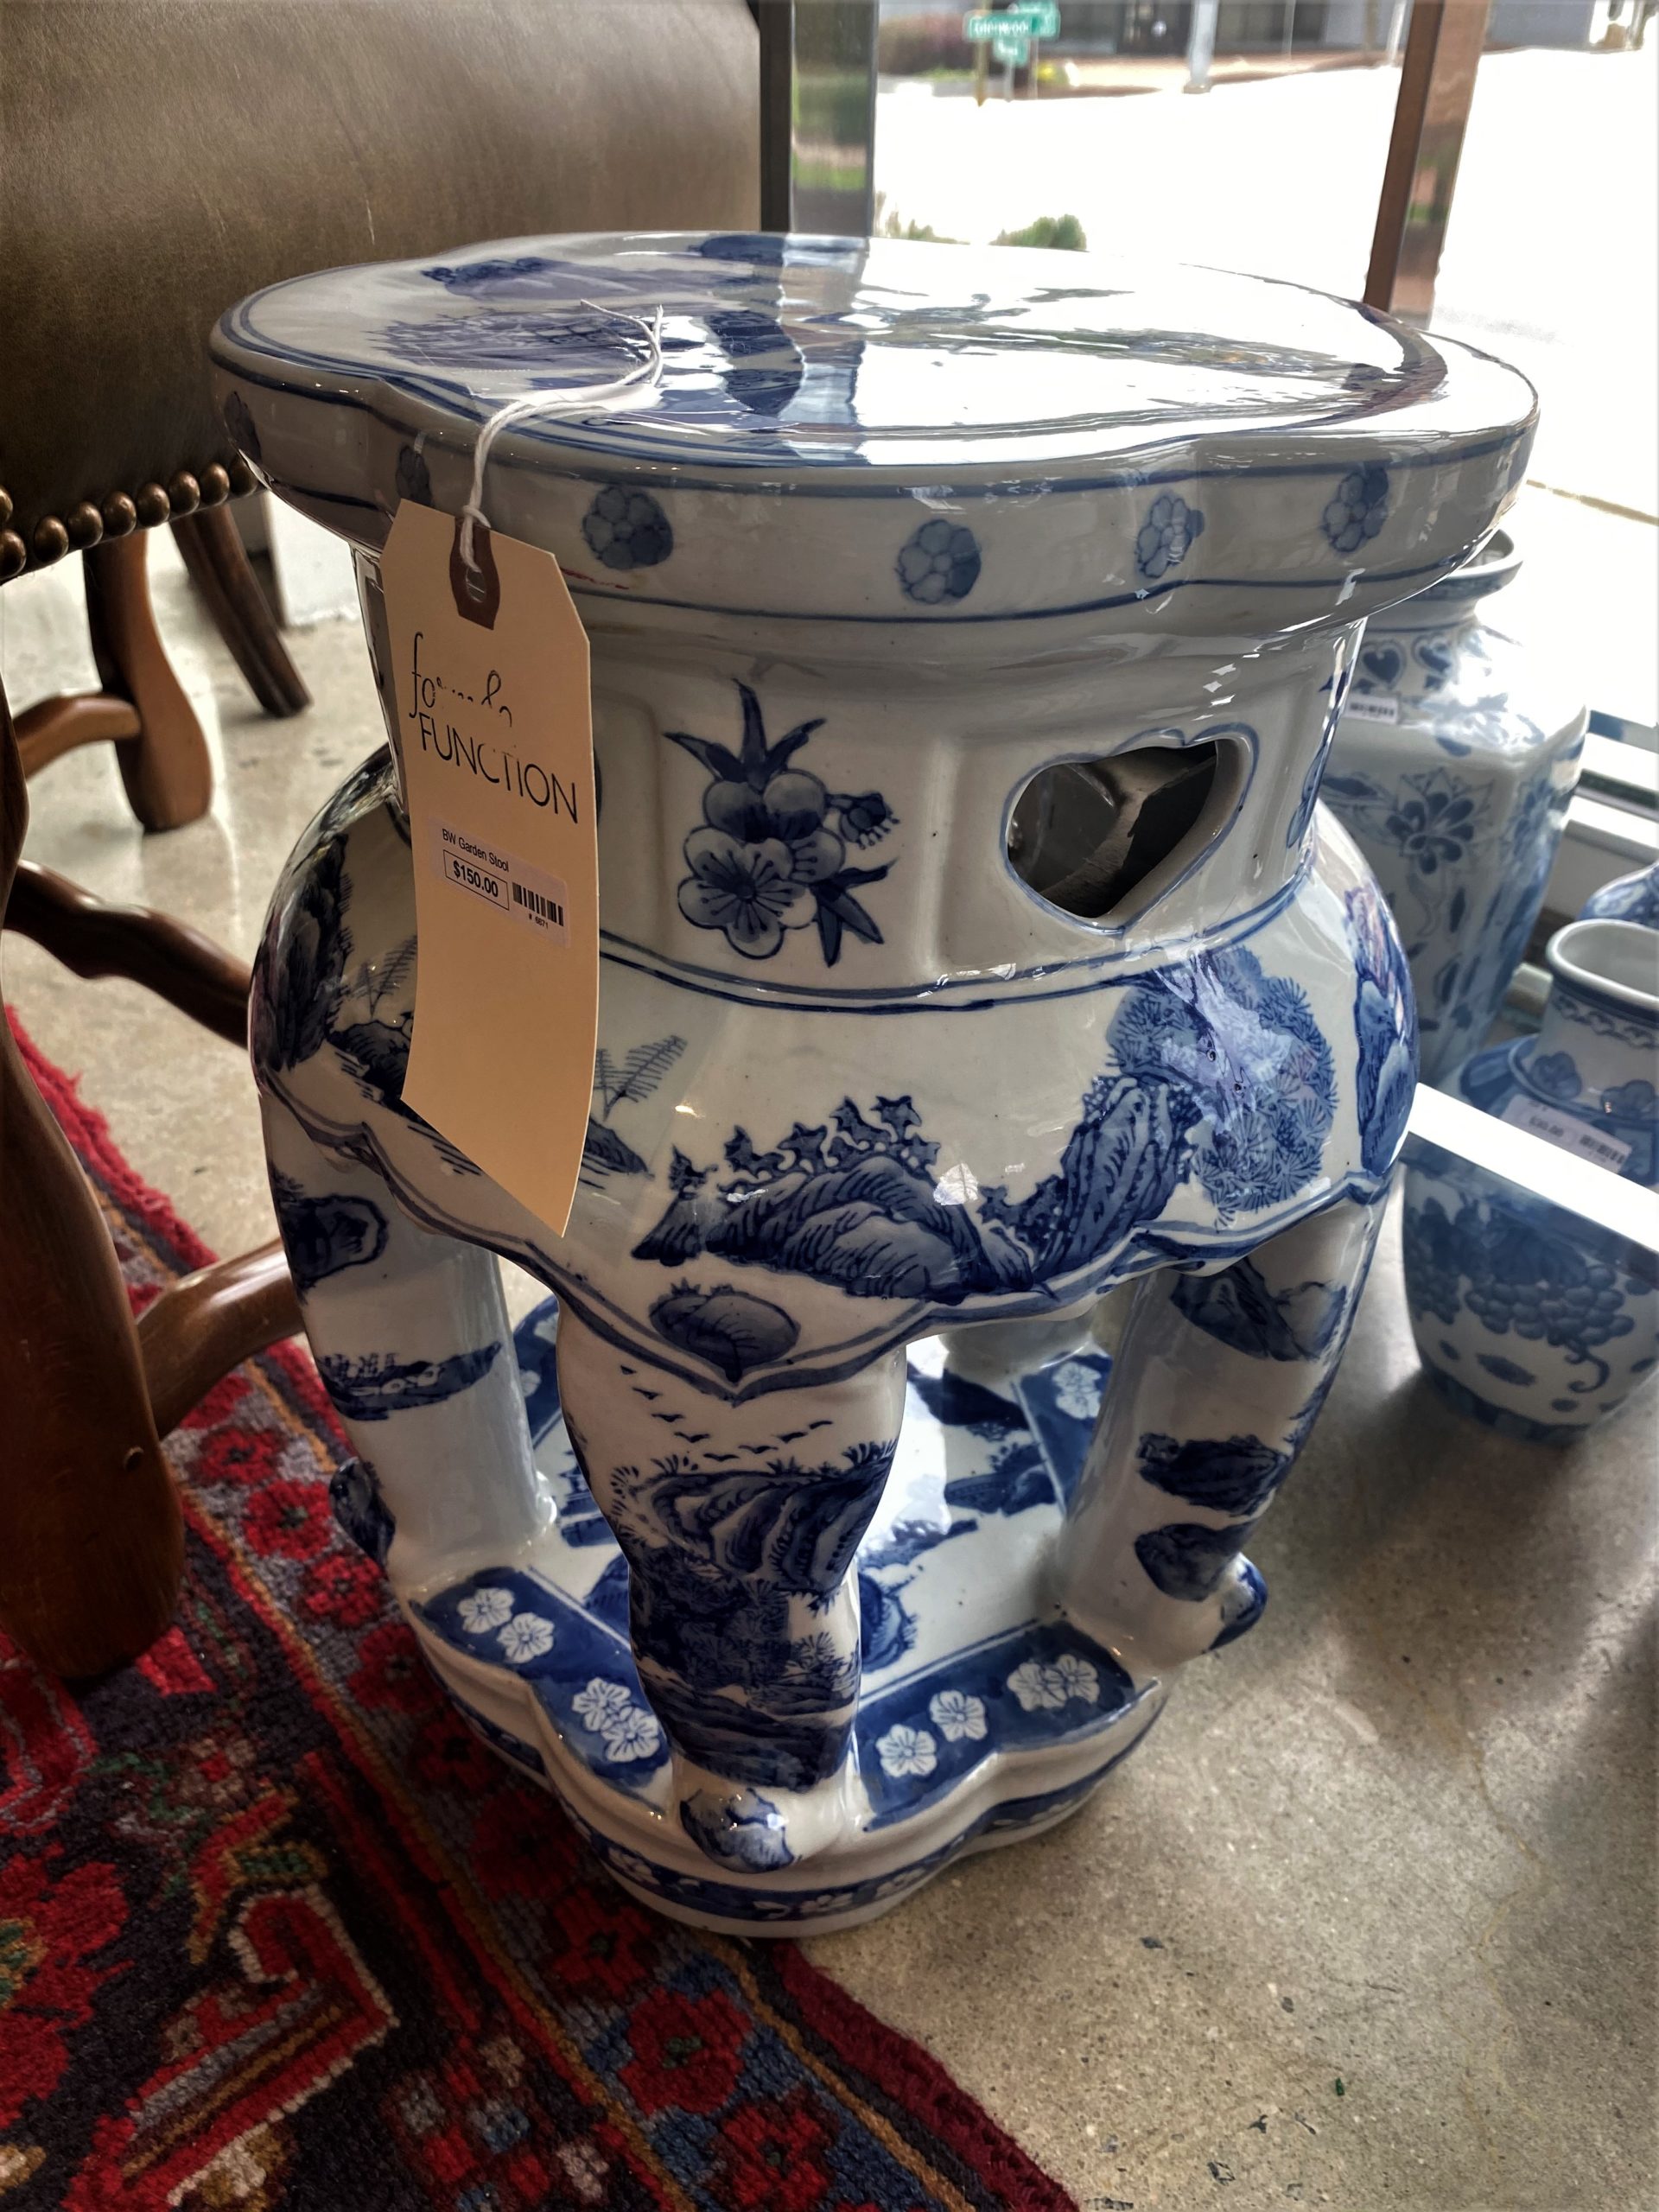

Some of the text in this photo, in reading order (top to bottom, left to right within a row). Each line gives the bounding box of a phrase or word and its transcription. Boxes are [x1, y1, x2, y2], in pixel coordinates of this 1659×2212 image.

[418, 711, 578, 824] FUNCTION
[442, 828, 509, 873] BW Garden Stool
[453, 860, 499, 898] $150.00
